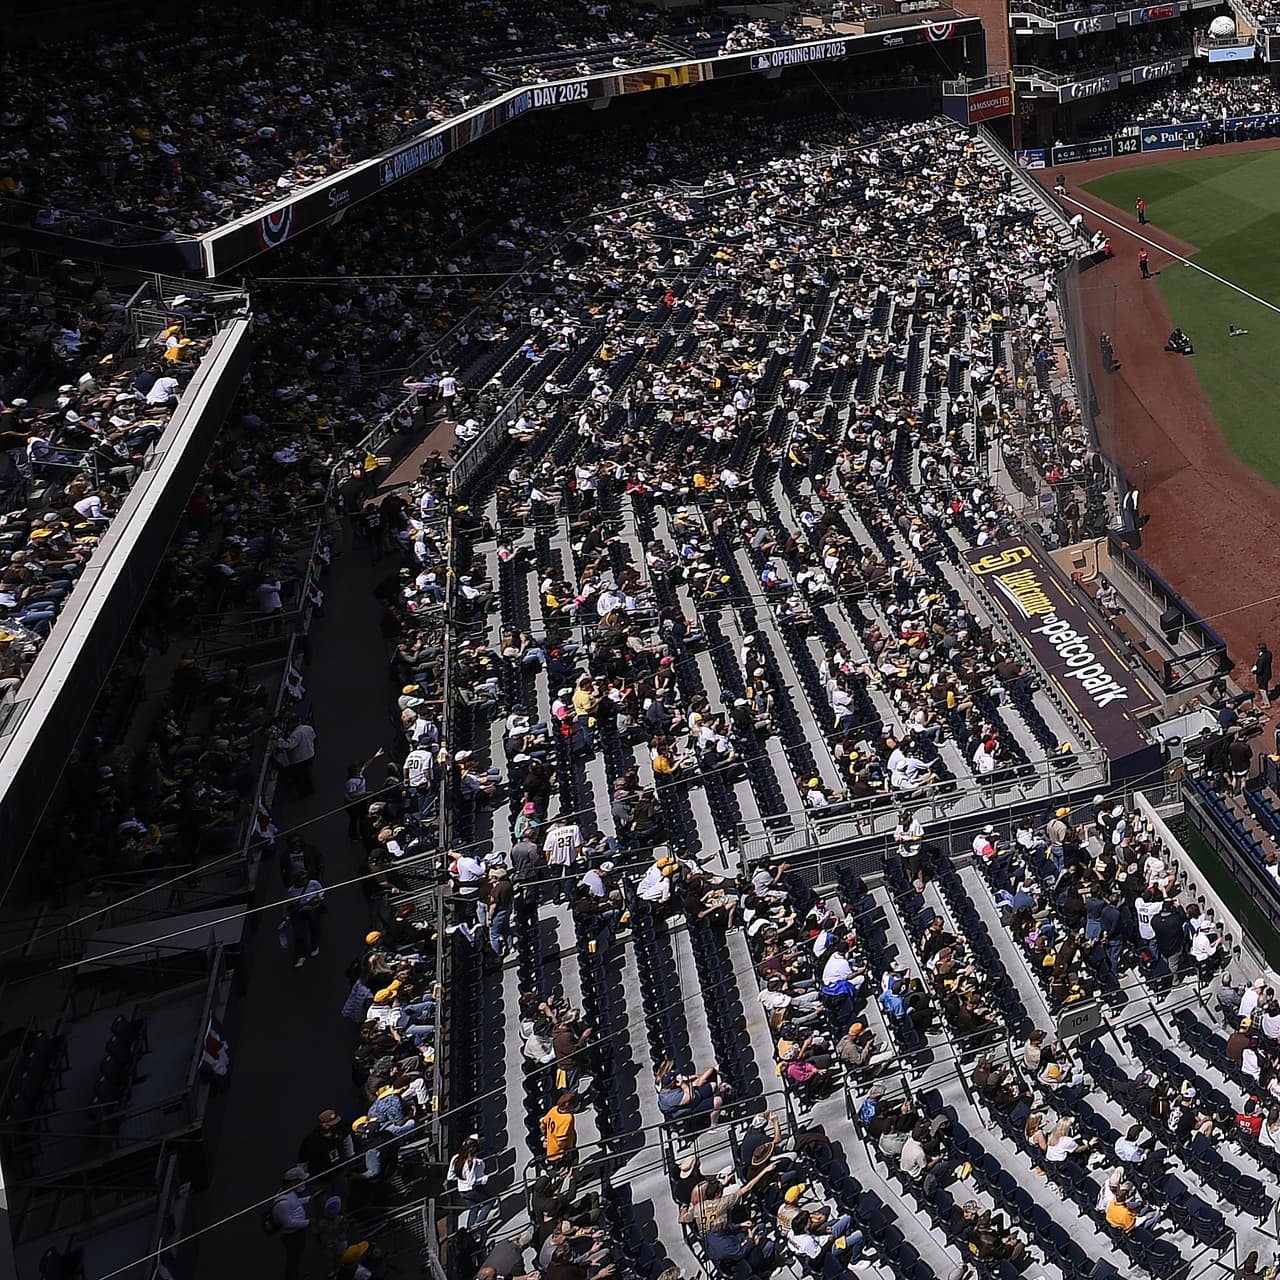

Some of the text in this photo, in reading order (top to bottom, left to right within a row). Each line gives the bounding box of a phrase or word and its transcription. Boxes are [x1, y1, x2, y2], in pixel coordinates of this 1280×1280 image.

[772, 41, 846, 67] OPENING DAY 2025
[534, 87, 557, 107] DAY
[559, 82, 588, 103] 2025
[976, 95, 1010, 111] MISSION FED
[1117, 139, 1138, 153] 342
[394, 147, 419, 178] OPENING
[969, 545, 1032, 575] SD
[1000, 568, 1056, 616] Welcome
[1031, 619, 1129, 708] petco park
[557, 835, 572, 848] 23
